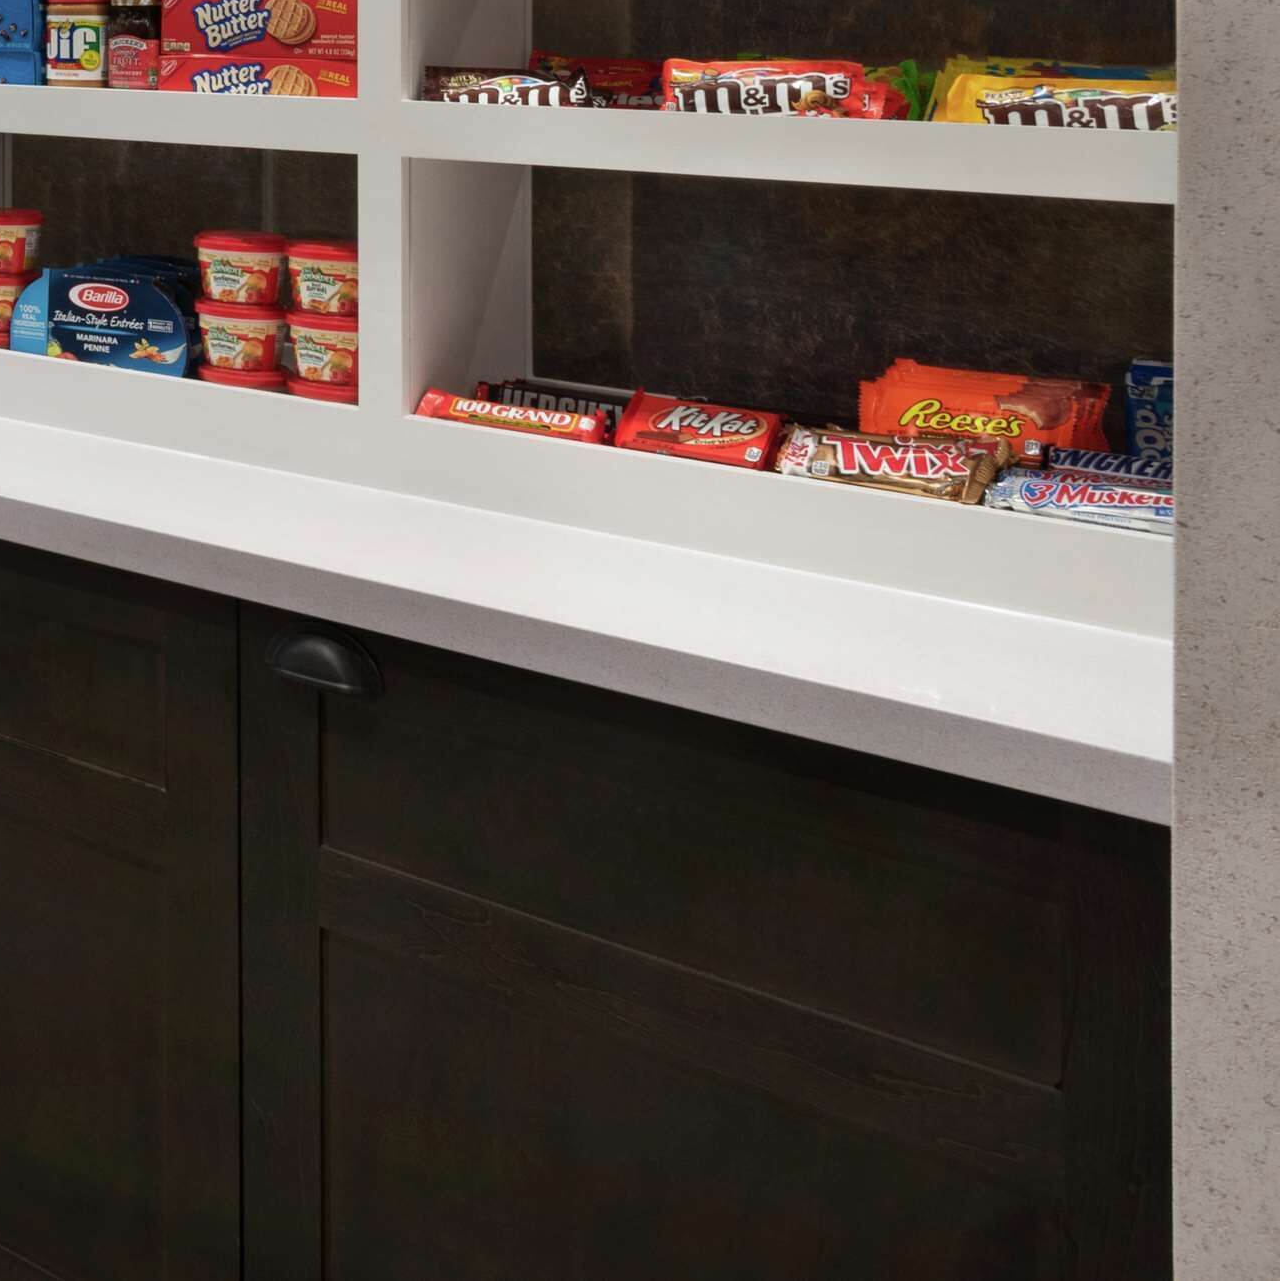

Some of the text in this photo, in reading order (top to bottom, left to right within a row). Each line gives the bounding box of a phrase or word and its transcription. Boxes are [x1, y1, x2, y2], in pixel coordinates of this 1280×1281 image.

[326, 0, 348, 11] REAL
[205, 10, 269, 49] Butter
[47, 27, 97, 59] Jif
[193, 64, 261, 93] Nutter
[328, 71, 351, 83] REAL
[82, 289, 124, 305] Barilla
[19, 304, 41, 314] 100%
[52, 310, 145, 330] Italian-Style Entrées
[76, 333, 119, 345] MARINARA
[83, 344, 110, 354] PENNE
[455, 398, 572, 427] 100 GRAND
[899, 399, 1026, 438] Reese's
[1024, 482, 1054, 504] 3
